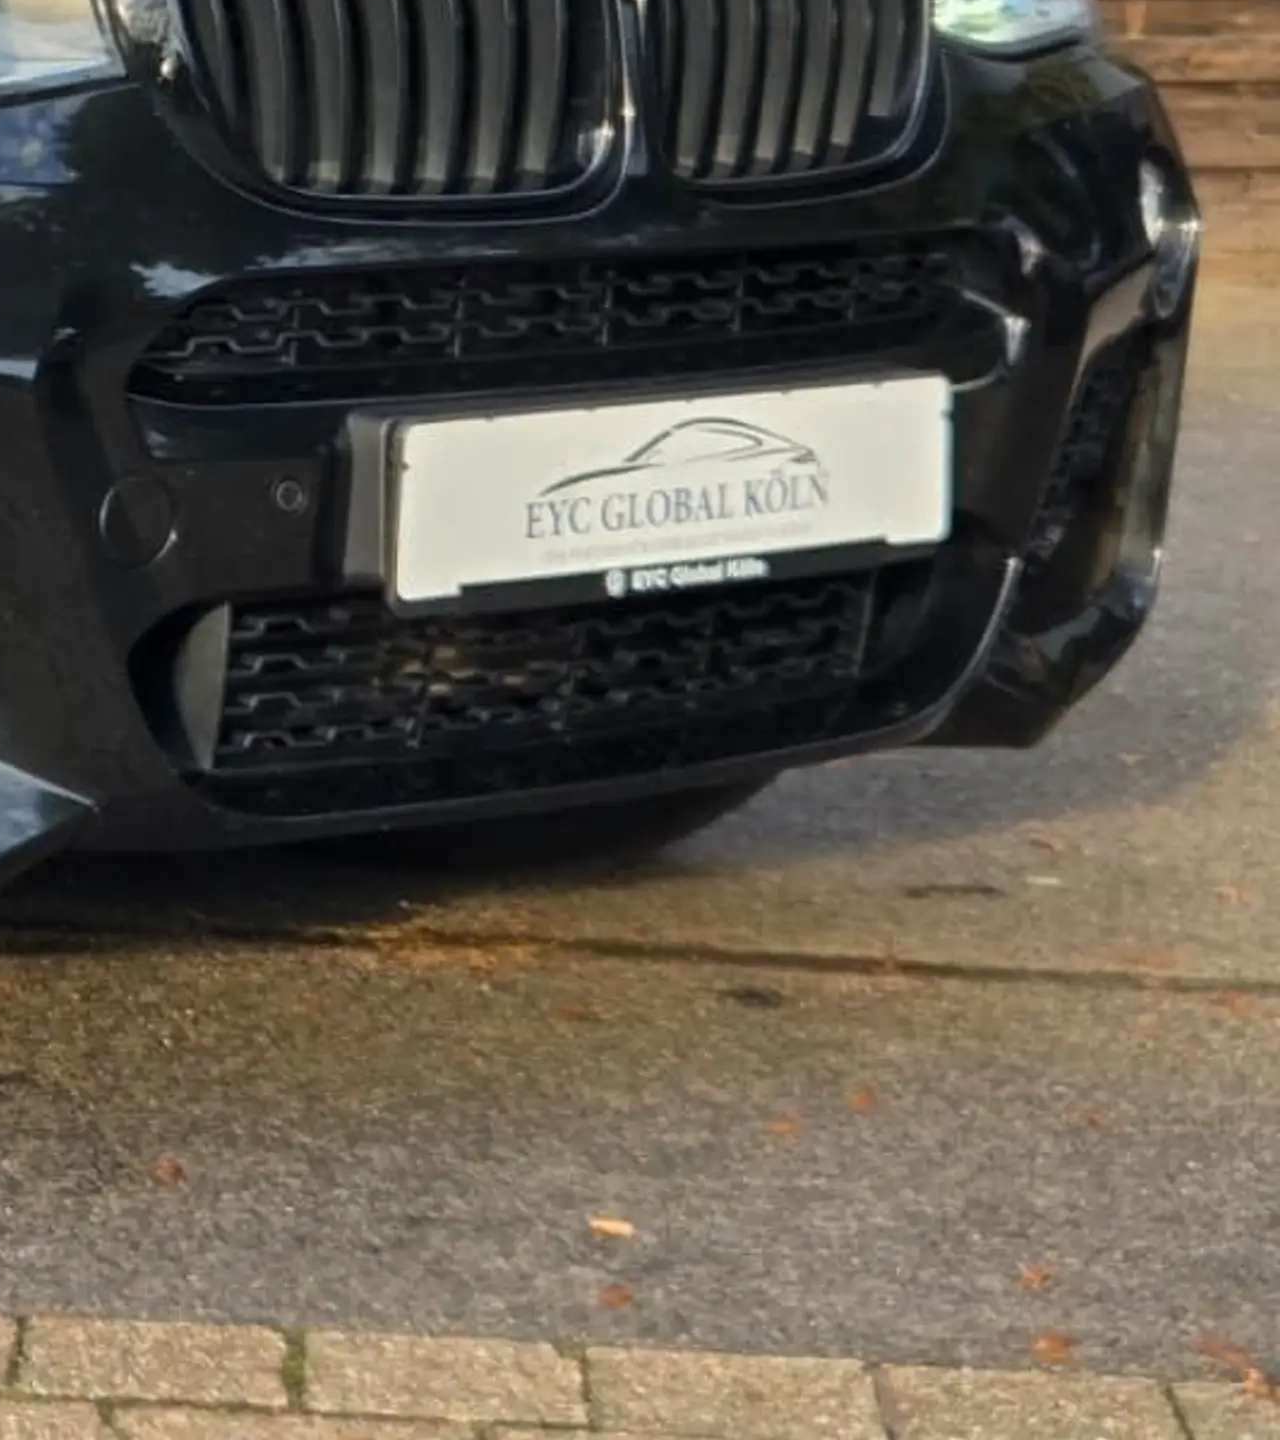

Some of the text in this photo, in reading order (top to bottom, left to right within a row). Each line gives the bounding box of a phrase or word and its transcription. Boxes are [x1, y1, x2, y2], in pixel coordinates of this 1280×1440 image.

[525, 468, 831, 539] EYC GLOBAL KÖLN
